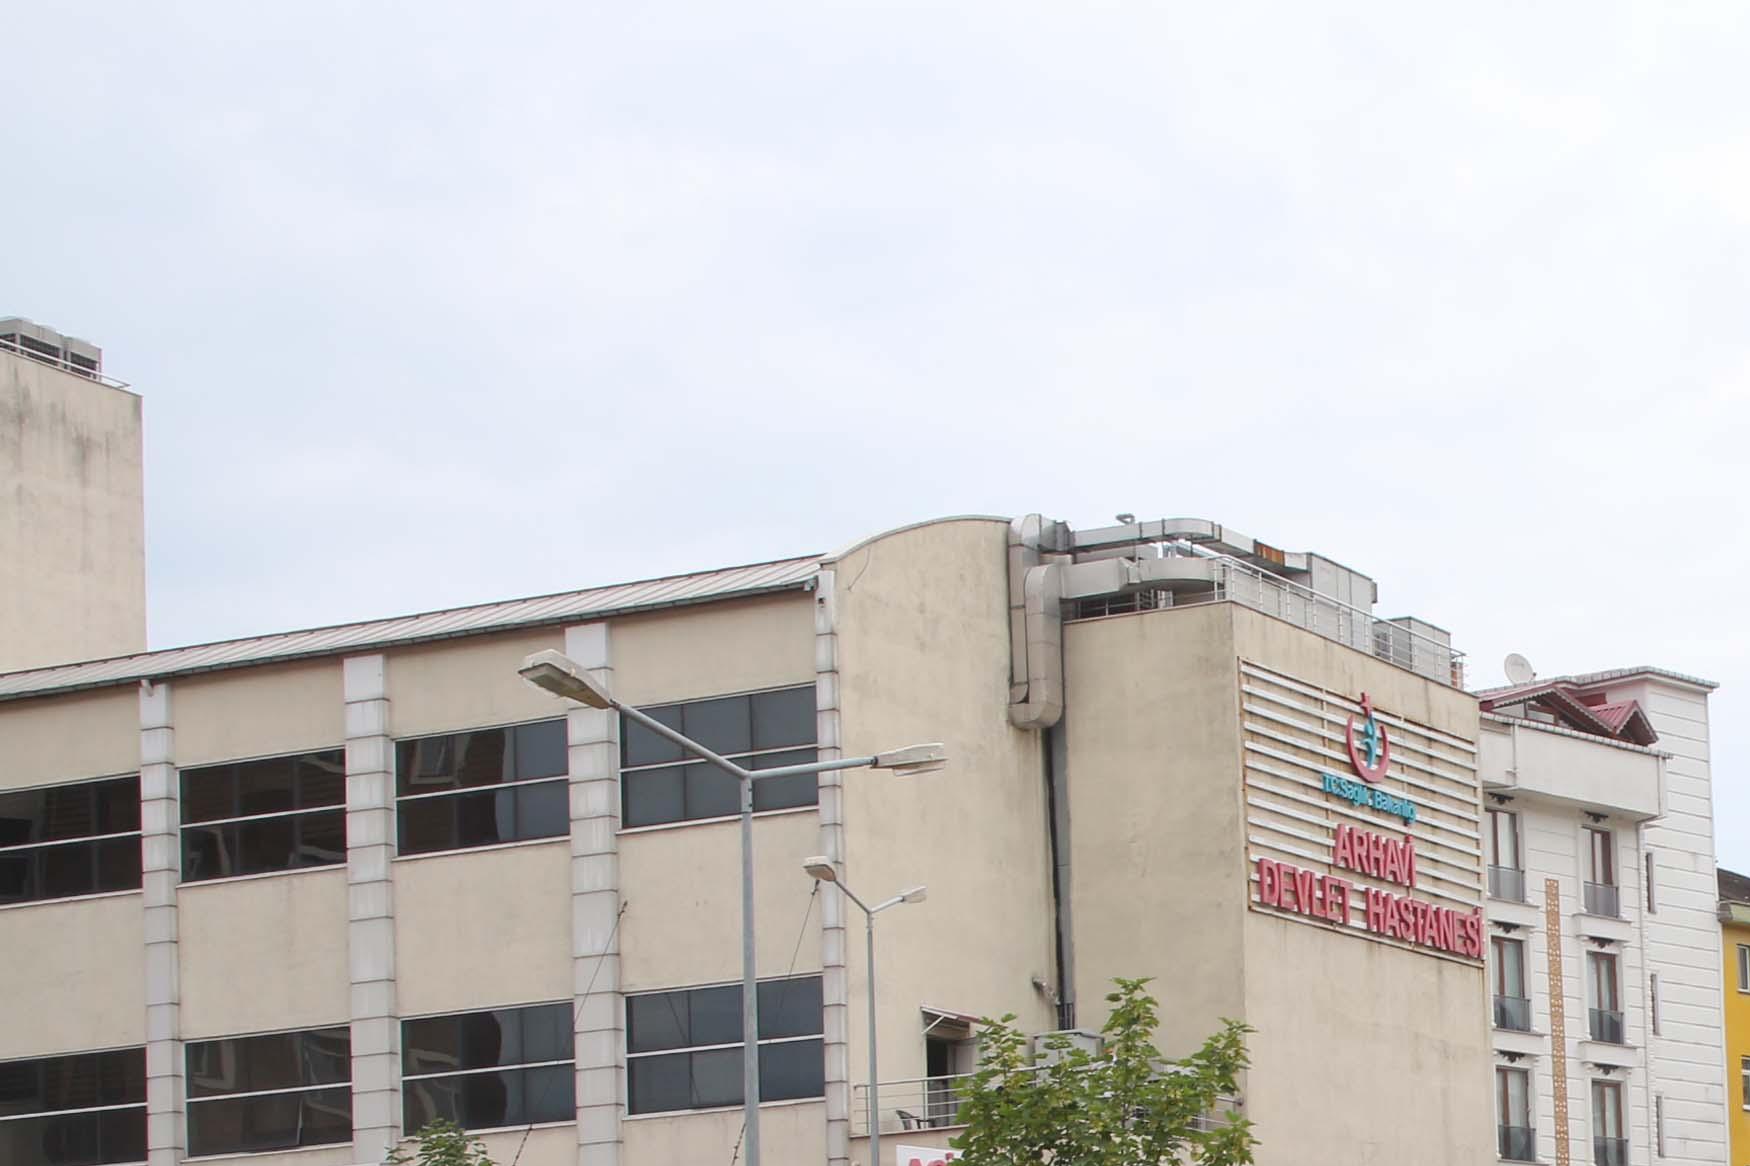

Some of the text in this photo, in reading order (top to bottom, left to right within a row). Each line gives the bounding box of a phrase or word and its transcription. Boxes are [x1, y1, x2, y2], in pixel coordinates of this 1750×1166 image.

[1333, 824, 1416, 887] ARHAVİ
[1258, 858, 1485, 959] DEVLET HASTANESİ
